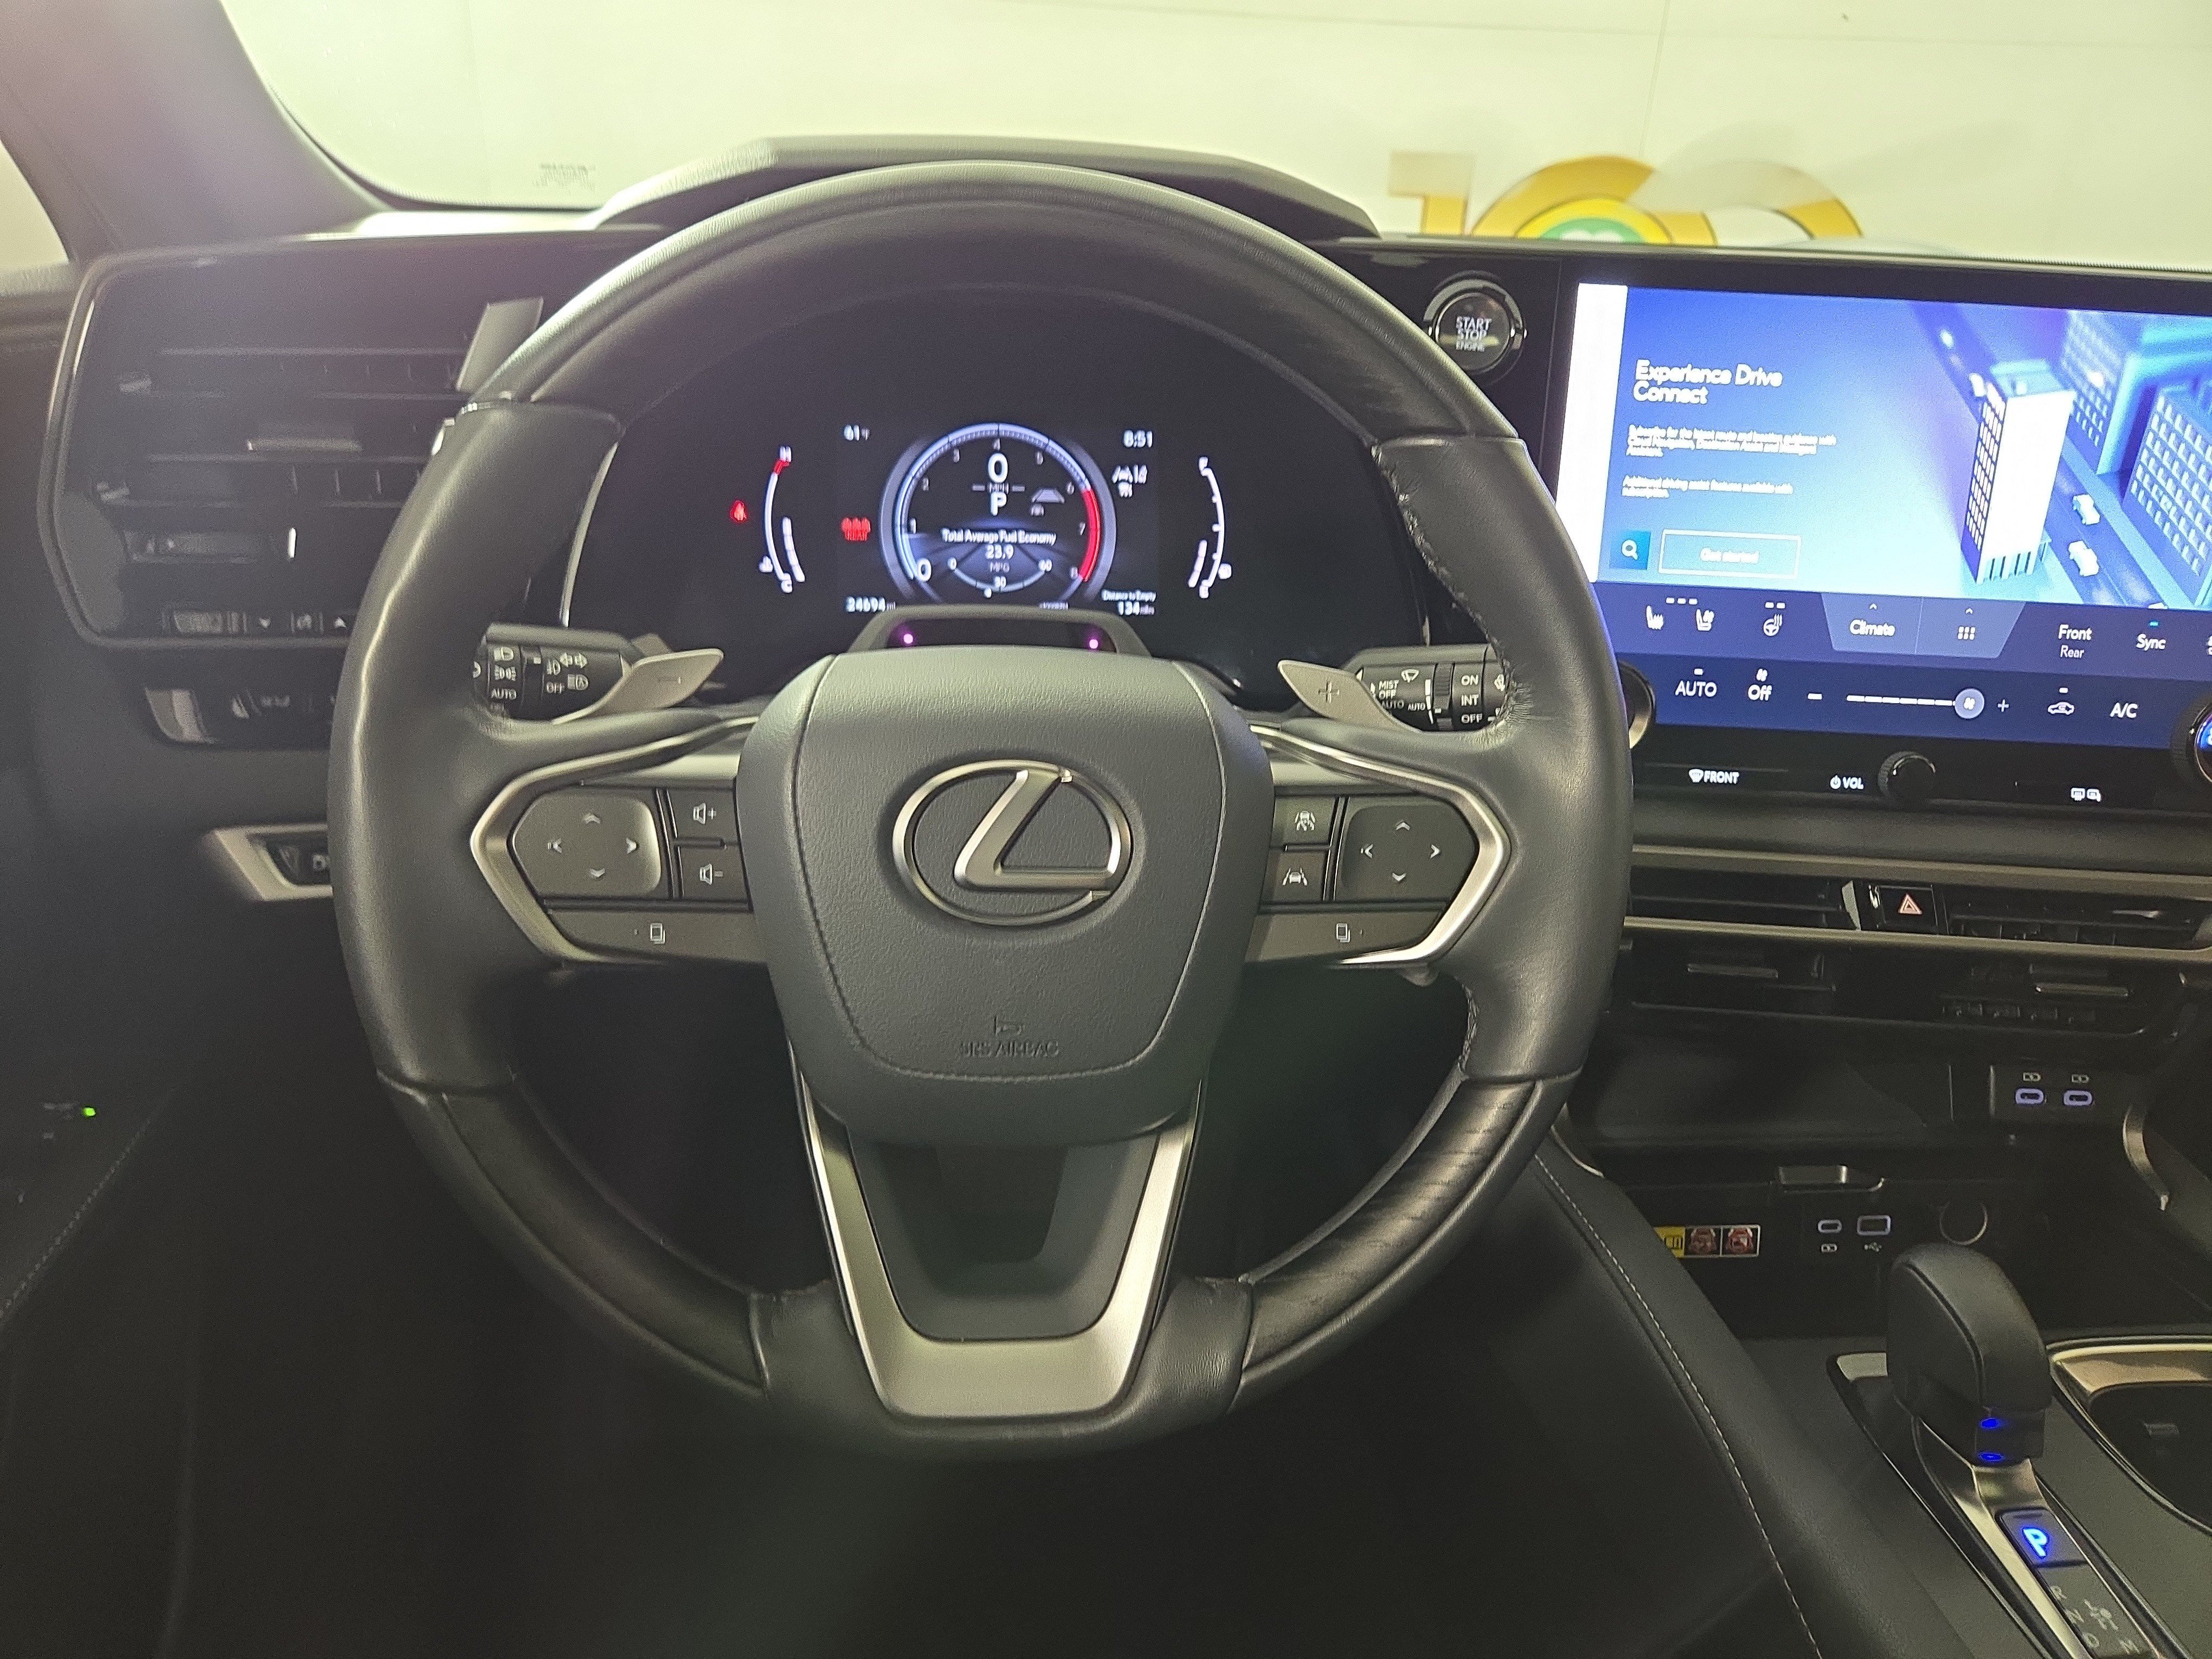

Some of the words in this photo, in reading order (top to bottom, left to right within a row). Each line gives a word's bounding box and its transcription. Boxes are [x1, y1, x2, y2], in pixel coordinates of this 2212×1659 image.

[1456, 316, 1493, 331] START
[1457, 329, 1487, 340] STOP
[1635, 359, 1732, 385] Experience
[1735, 363, 1783, 387] Drive
[1633, 380, 1708, 404] Connect
[988, 452, 1008, 483] 0
[990, 492, 1007, 516] P
[942, 528, 963, 543] Total
[964, 529, 999, 544] Average
[998, 529, 1017, 543] Fuel
[1018, 529, 1057, 546] Economy
[985, 544, 1014, 560] 23.9
[917, 558, 932, 582] 0
[948, 557, 957, 570] 0
[1850, 619, 1895, 636] Climate
[2058, 624, 2092, 641] Front
[2136, 634, 2166, 651] Sync
[2060, 645, 2085, 658] Rear
[1379, 680, 1399, 691] MIST
[1461, 675, 1479, 686] ON
[491, 688, 517, 700] AUTO
[1379, 689, 1397, 700] OFF
[1461, 695, 1480, 706] INT
[1675, 680, 1717, 697] AUTO
[1748, 684, 1772, 701] Off
[2110, 702, 2138, 718] A/C
[1407, 703, 1426, 712] AUTO
[1461, 713, 1483, 724] OFF
[1703, 770, 1740, 785] FRONT
[1842, 776, 1864, 790] VOL
[2022, 1527, 2049, 1558] P
[2050, 1585, 2067, 1600] R
